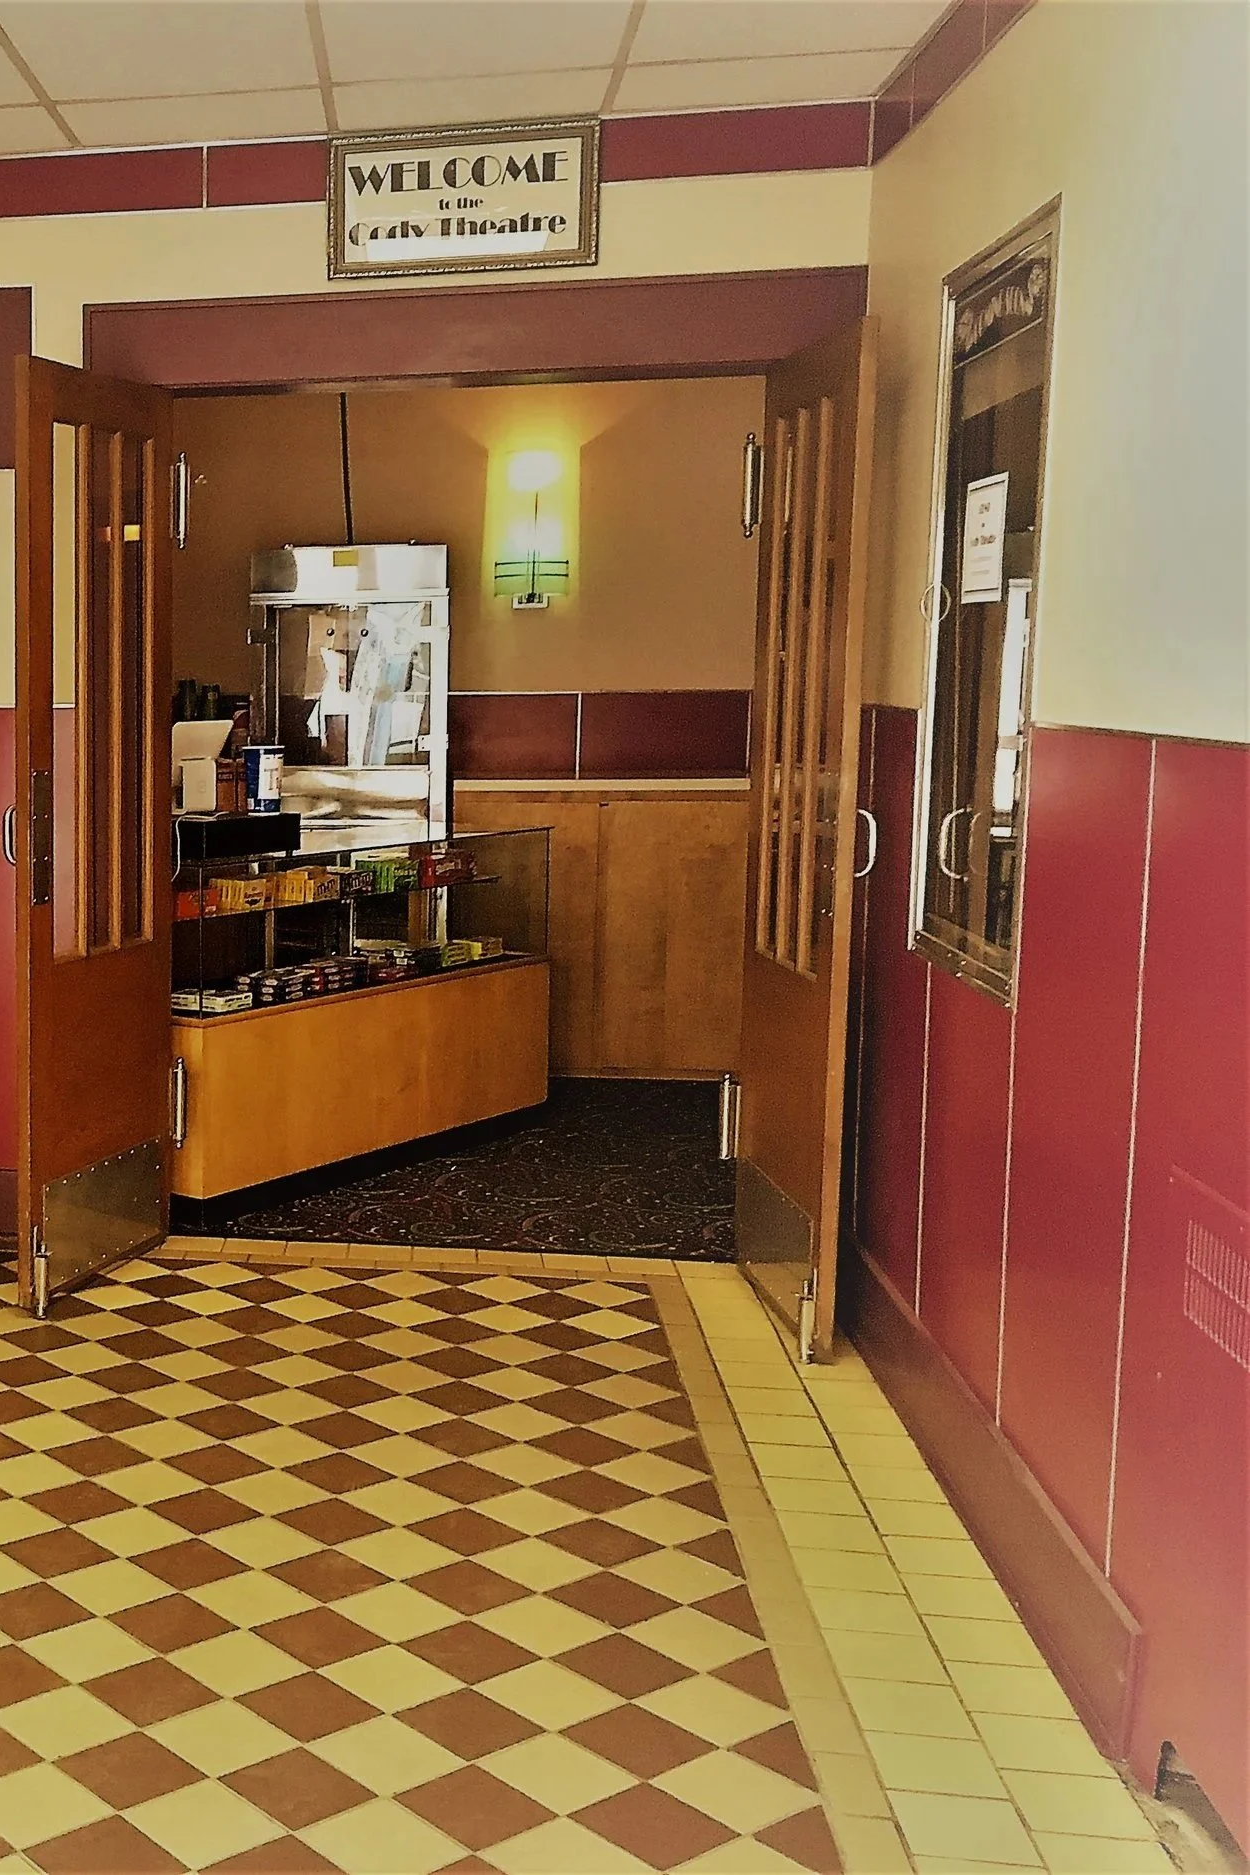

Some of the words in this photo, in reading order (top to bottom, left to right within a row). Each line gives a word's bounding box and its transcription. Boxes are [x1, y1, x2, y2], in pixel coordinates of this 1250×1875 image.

[347, 151, 569, 197] WELCOME
[438, 198, 451, 211] to
[456, 197, 484, 210] the
[434, 211, 568, 239] Theatre
